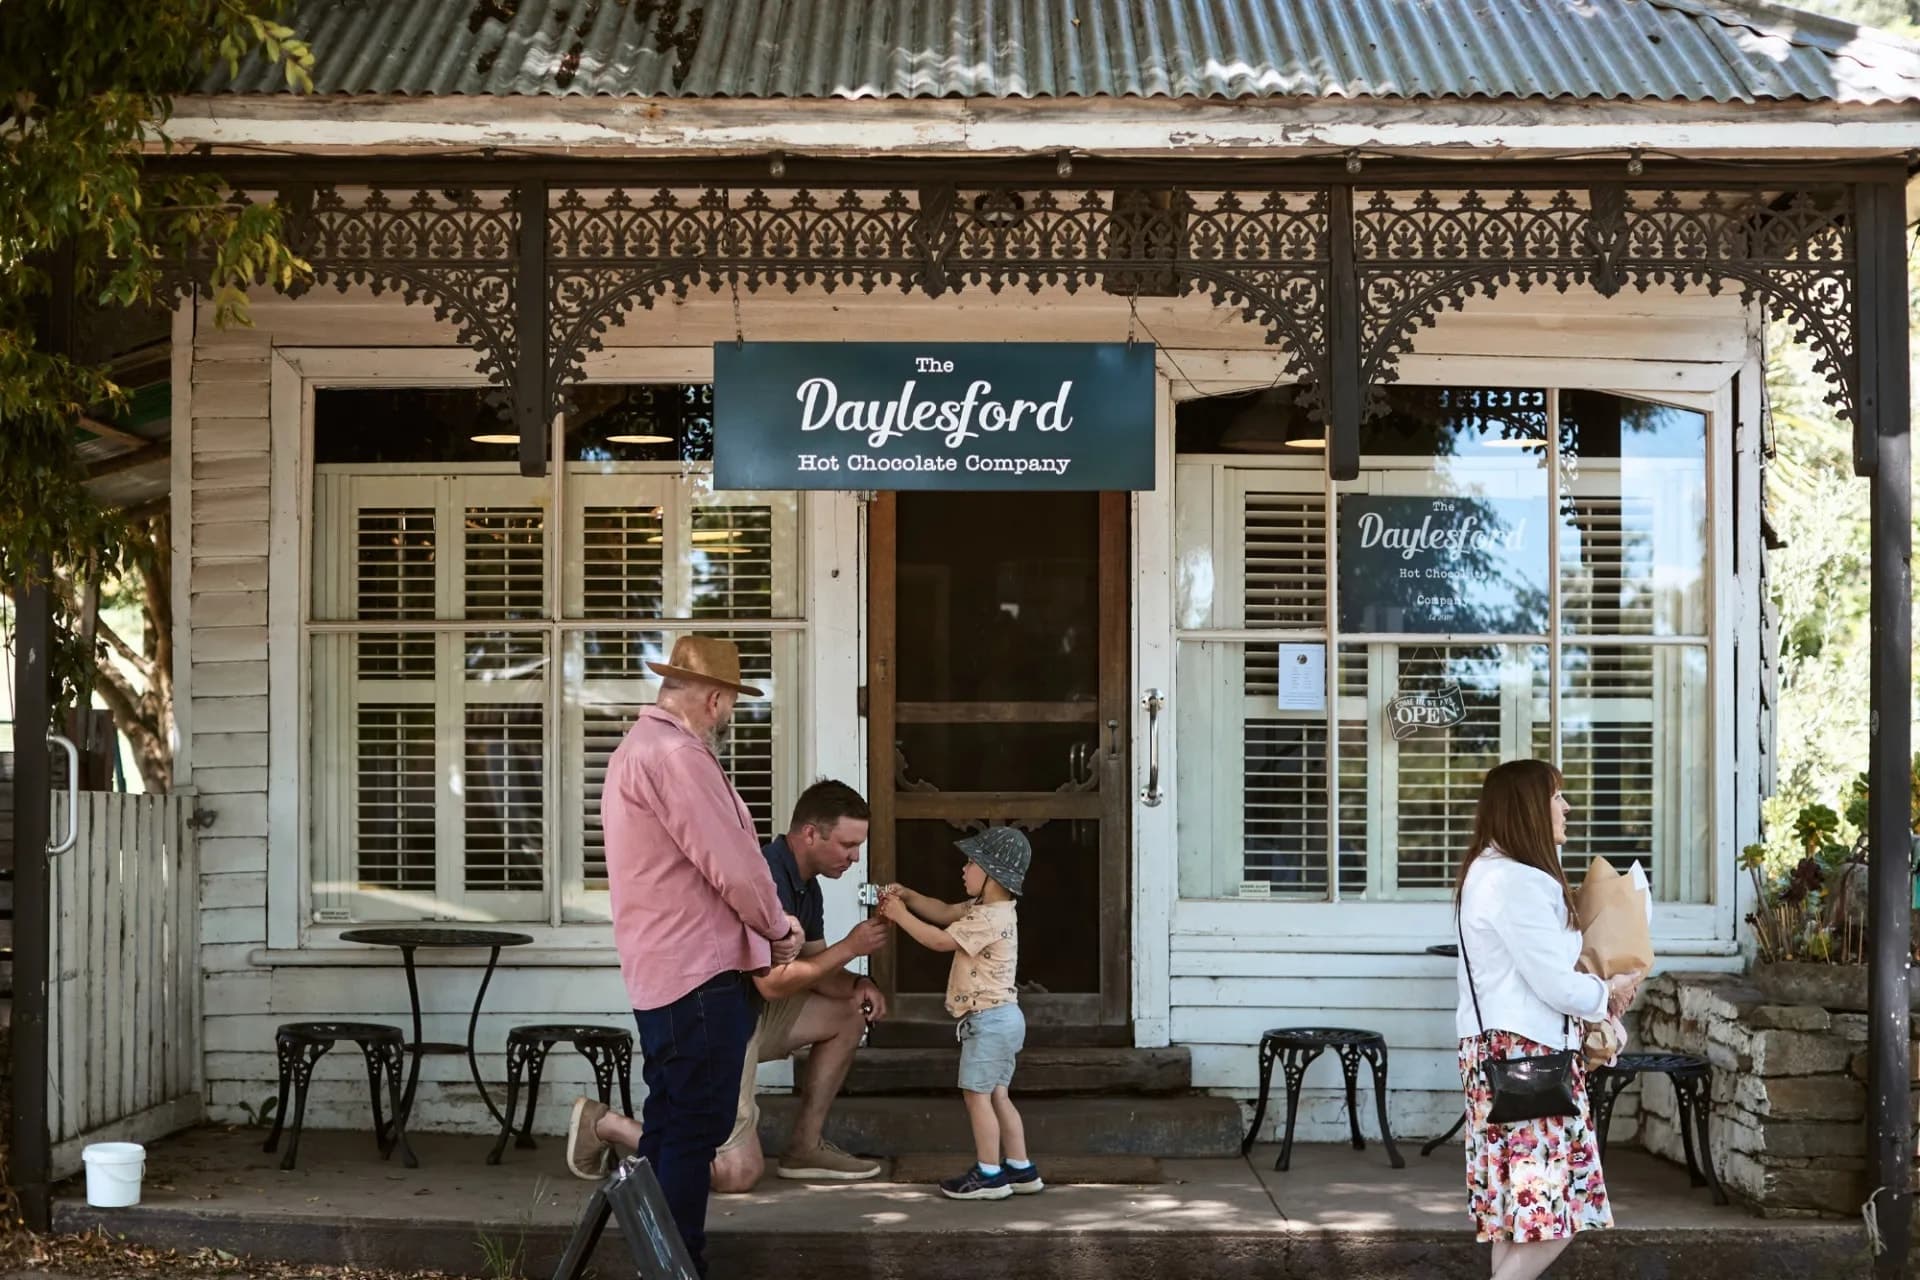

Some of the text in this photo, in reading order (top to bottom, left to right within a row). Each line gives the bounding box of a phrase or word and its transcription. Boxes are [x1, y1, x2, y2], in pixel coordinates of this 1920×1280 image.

[916, 357, 954, 373] The
[796, 377, 1074, 449] Daylesford
[798, 454, 1071, 475] Hot Chocolate Company
[1432, 501, 1455, 512] The
[1358, 512, 1527, 560] Daylesford
[1400, 568, 1484, 578] Hot Chocol
[1397, 702, 1458, 724] OPEN
